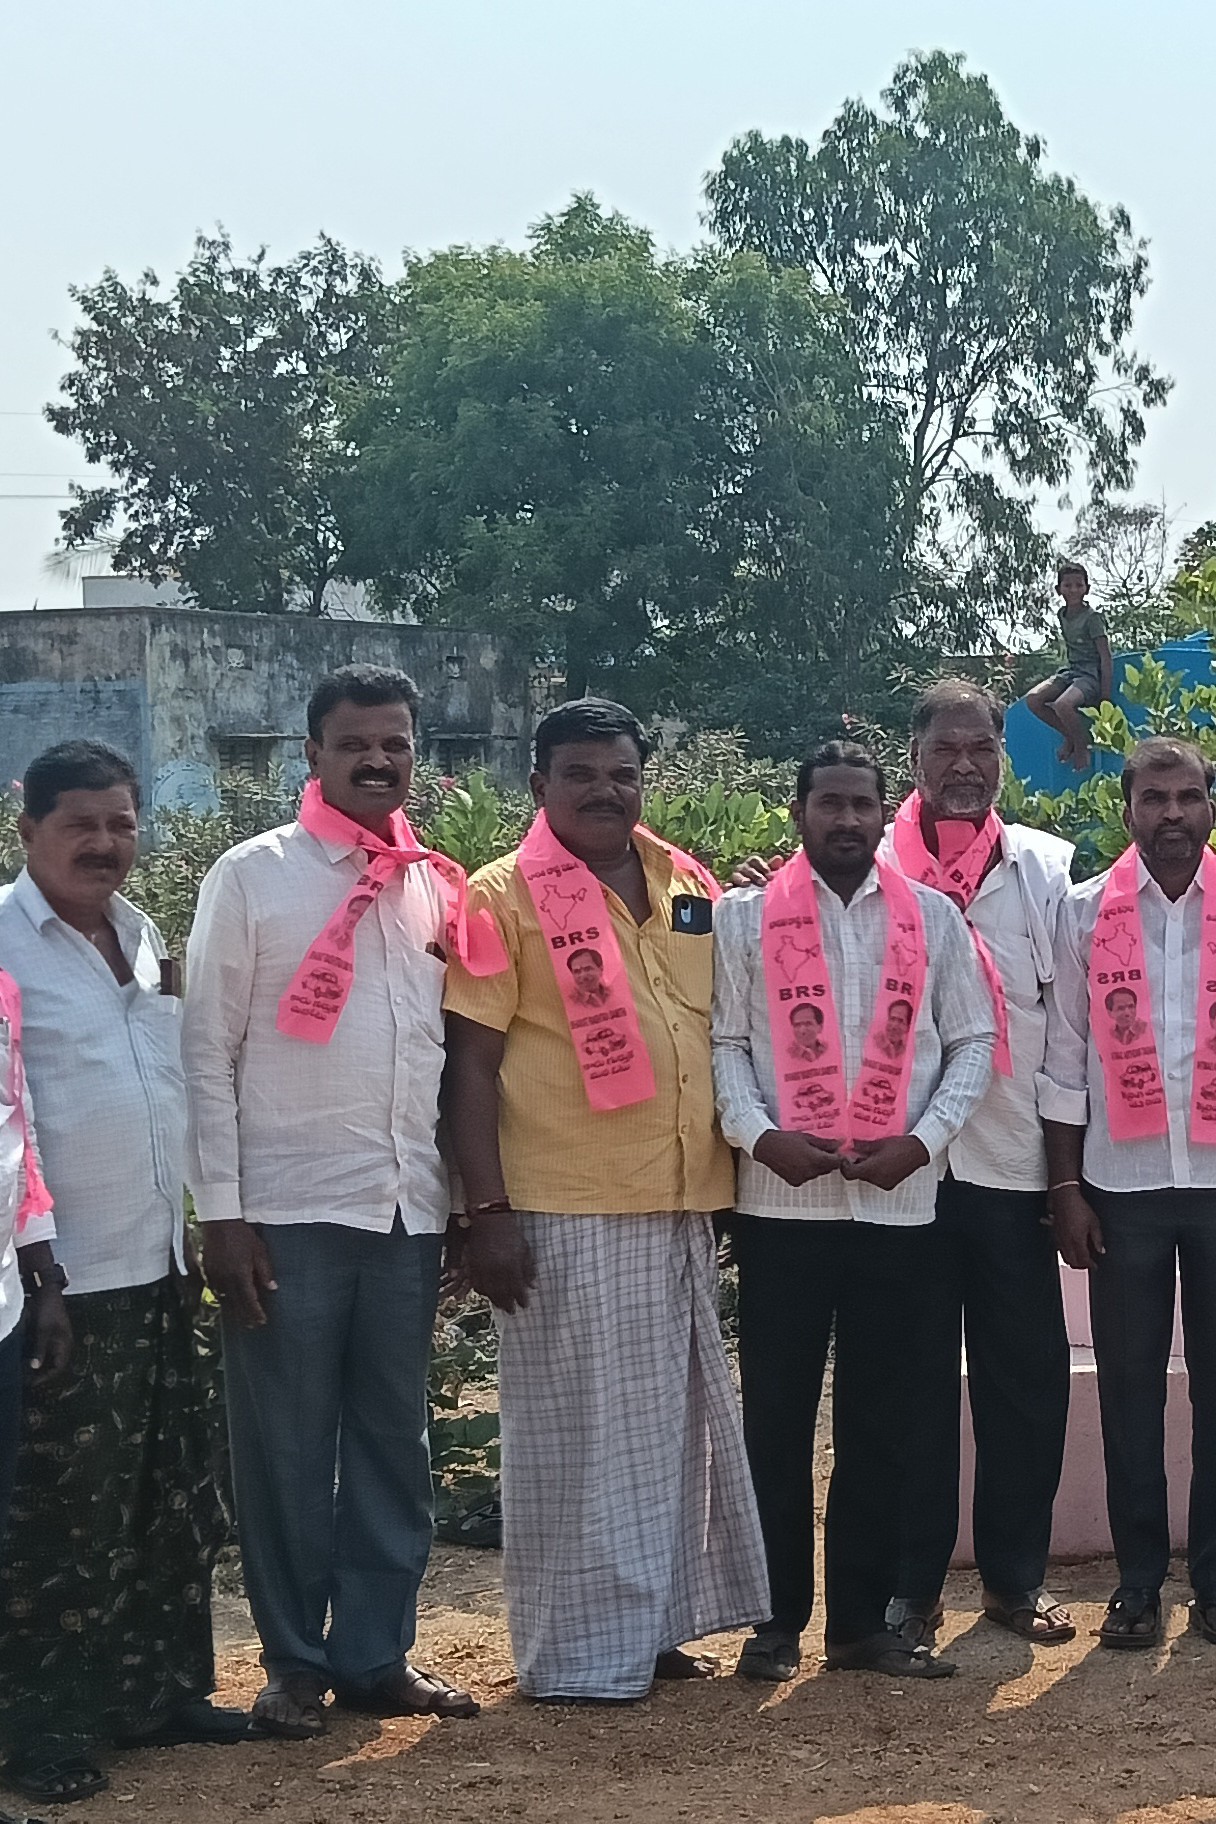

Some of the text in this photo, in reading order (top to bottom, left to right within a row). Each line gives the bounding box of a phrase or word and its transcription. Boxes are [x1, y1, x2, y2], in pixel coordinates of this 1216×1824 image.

[356, 874, 385, 893] BR
[949, 868, 972, 897] BR
[550, 926, 601, 950] BRS
[778, 984, 826, 1001] BRS
[884, 977, 914, 996] BR
